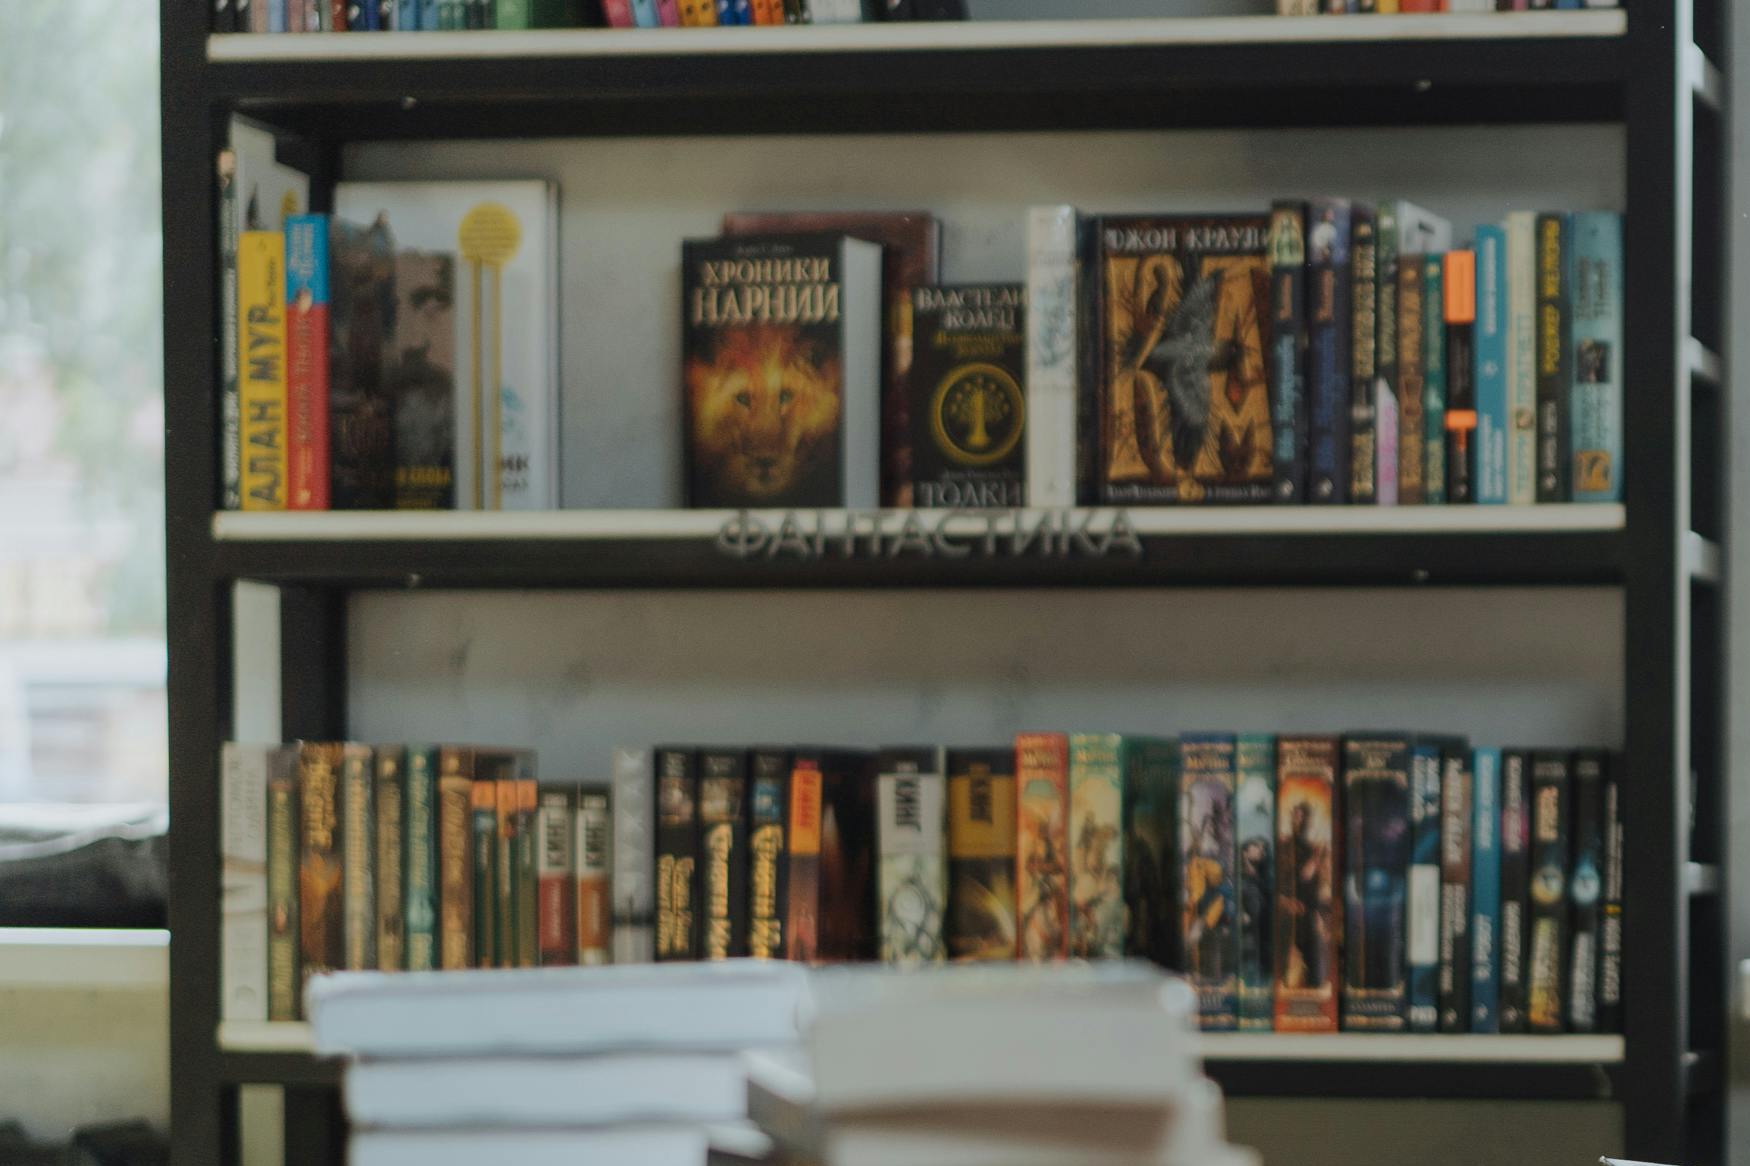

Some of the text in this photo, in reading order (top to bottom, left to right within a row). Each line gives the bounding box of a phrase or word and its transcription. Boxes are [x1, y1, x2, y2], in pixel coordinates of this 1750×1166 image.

[703, 257, 831, 286] ХРОНИКИ
[692, 284, 840, 326] НАРНИИ
[915, 288, 1026, 309] ВЛАСТЕЛИ
[247, 303, 283, 505] АЛАН МУР
[918, 481, 1021, 506] ТОЛКИ
[717, 507, 1143, 557] ФАНТАСТИКА
